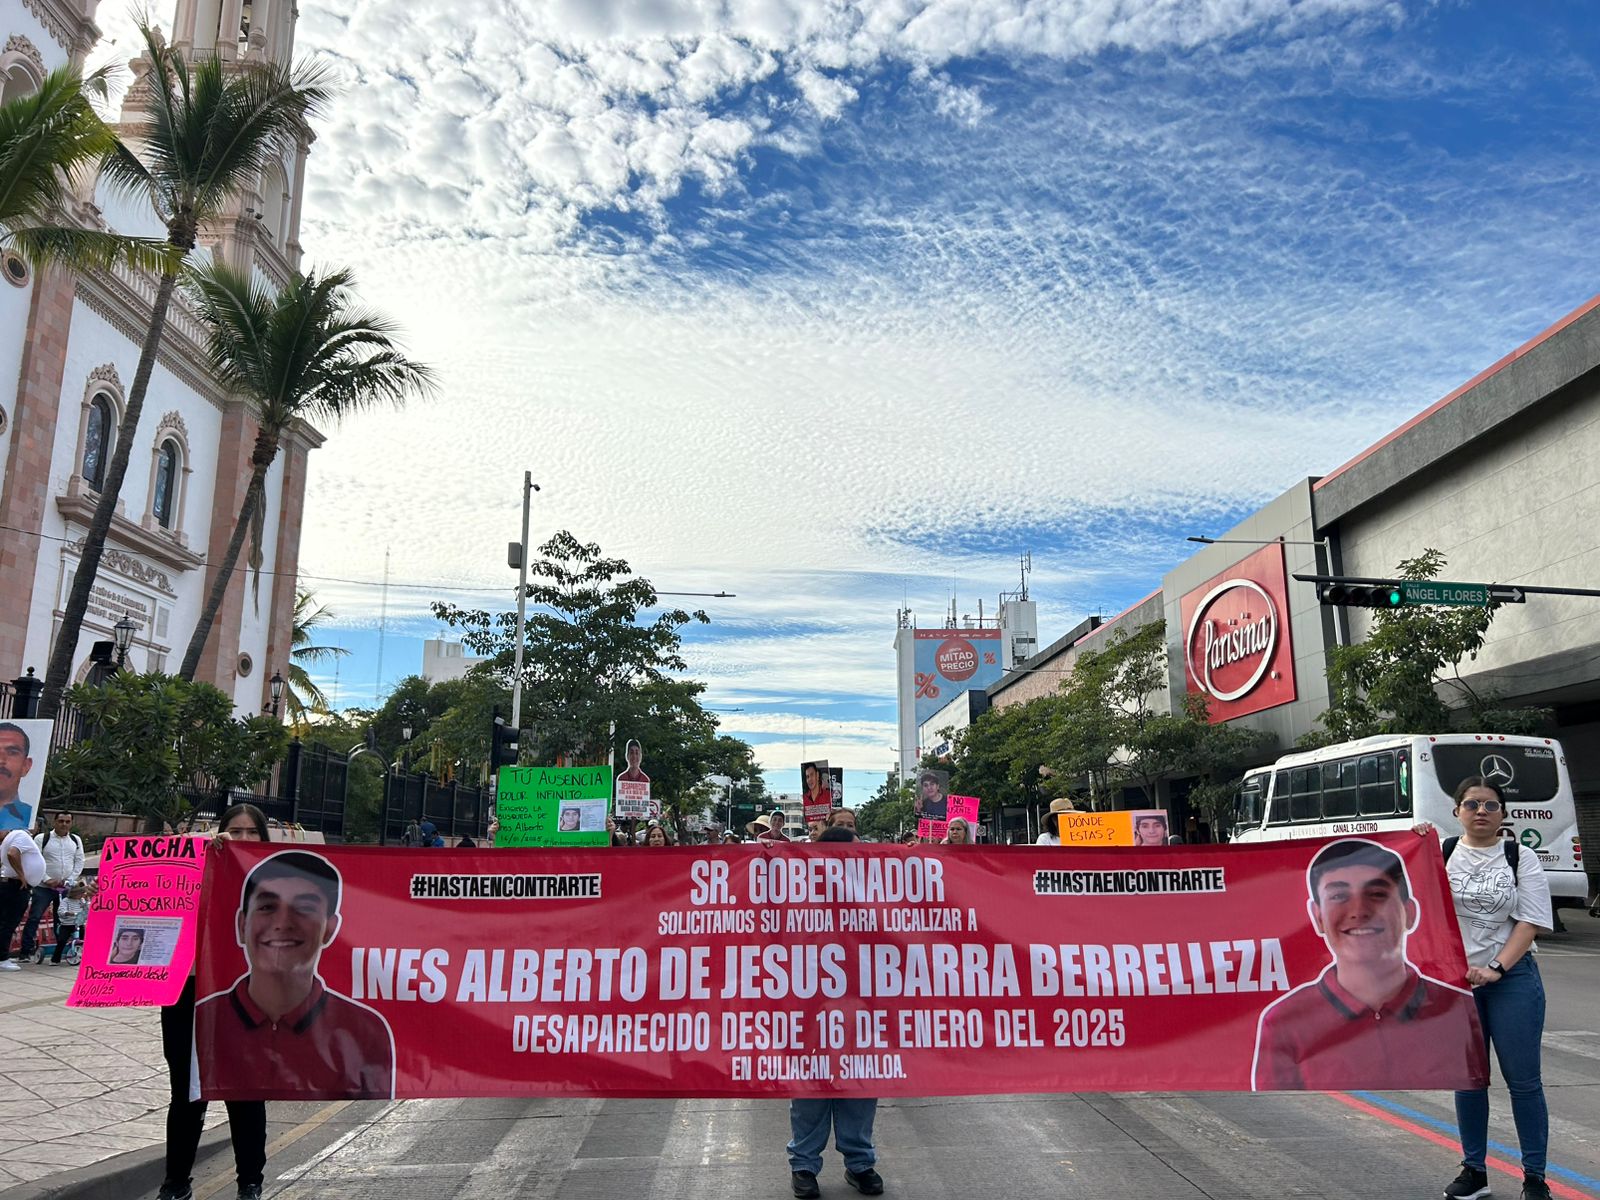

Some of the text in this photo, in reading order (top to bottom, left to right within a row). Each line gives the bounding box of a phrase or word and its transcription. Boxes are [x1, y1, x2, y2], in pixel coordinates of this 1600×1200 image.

[1406, 588, 1484, 602] ANGEL FLORES
[940, 651, 974, 662] MITAD
[940, 660, 975, 671] PRECIO
[511, 769, 533, 786] TÚ
[538, 772, 604, 787] AUSENCIA
[500, 791, 527, 801] DOLOR
[1511, 809, 1553, 820] CENTRO
[1332, 822, 1379, 834] CANAL 3-CENTRO
[120, 874, 149, 889] Fuera
[176, 874, 202, 896] Hijo
[411, 874, 601, 898] #HASTAENCONTRARTE
[690, 857, 945, 905] SR. GOBERNADOR
[1034, 868, 1225, 894] #HASTAENCONTRARTE
[118, 893, 196, 912] BUSCARIAS
[658, 907, 978, 936] SOLICITAMOS SU AYUDA PARA LOCALIZAR A
[352, 938, 1291, 1003] INES ALBERTO DE JESUS IBARRA BERRELLEZA
[76, 985, 114, 998] 16/01/25
[512, 1008, 1127, 1054] DESAPARECIDO DESDE 16 DE ENERO DEL 2025
[731, 1049, 908, 1084] EN CULIACÁN, SINALOA.
